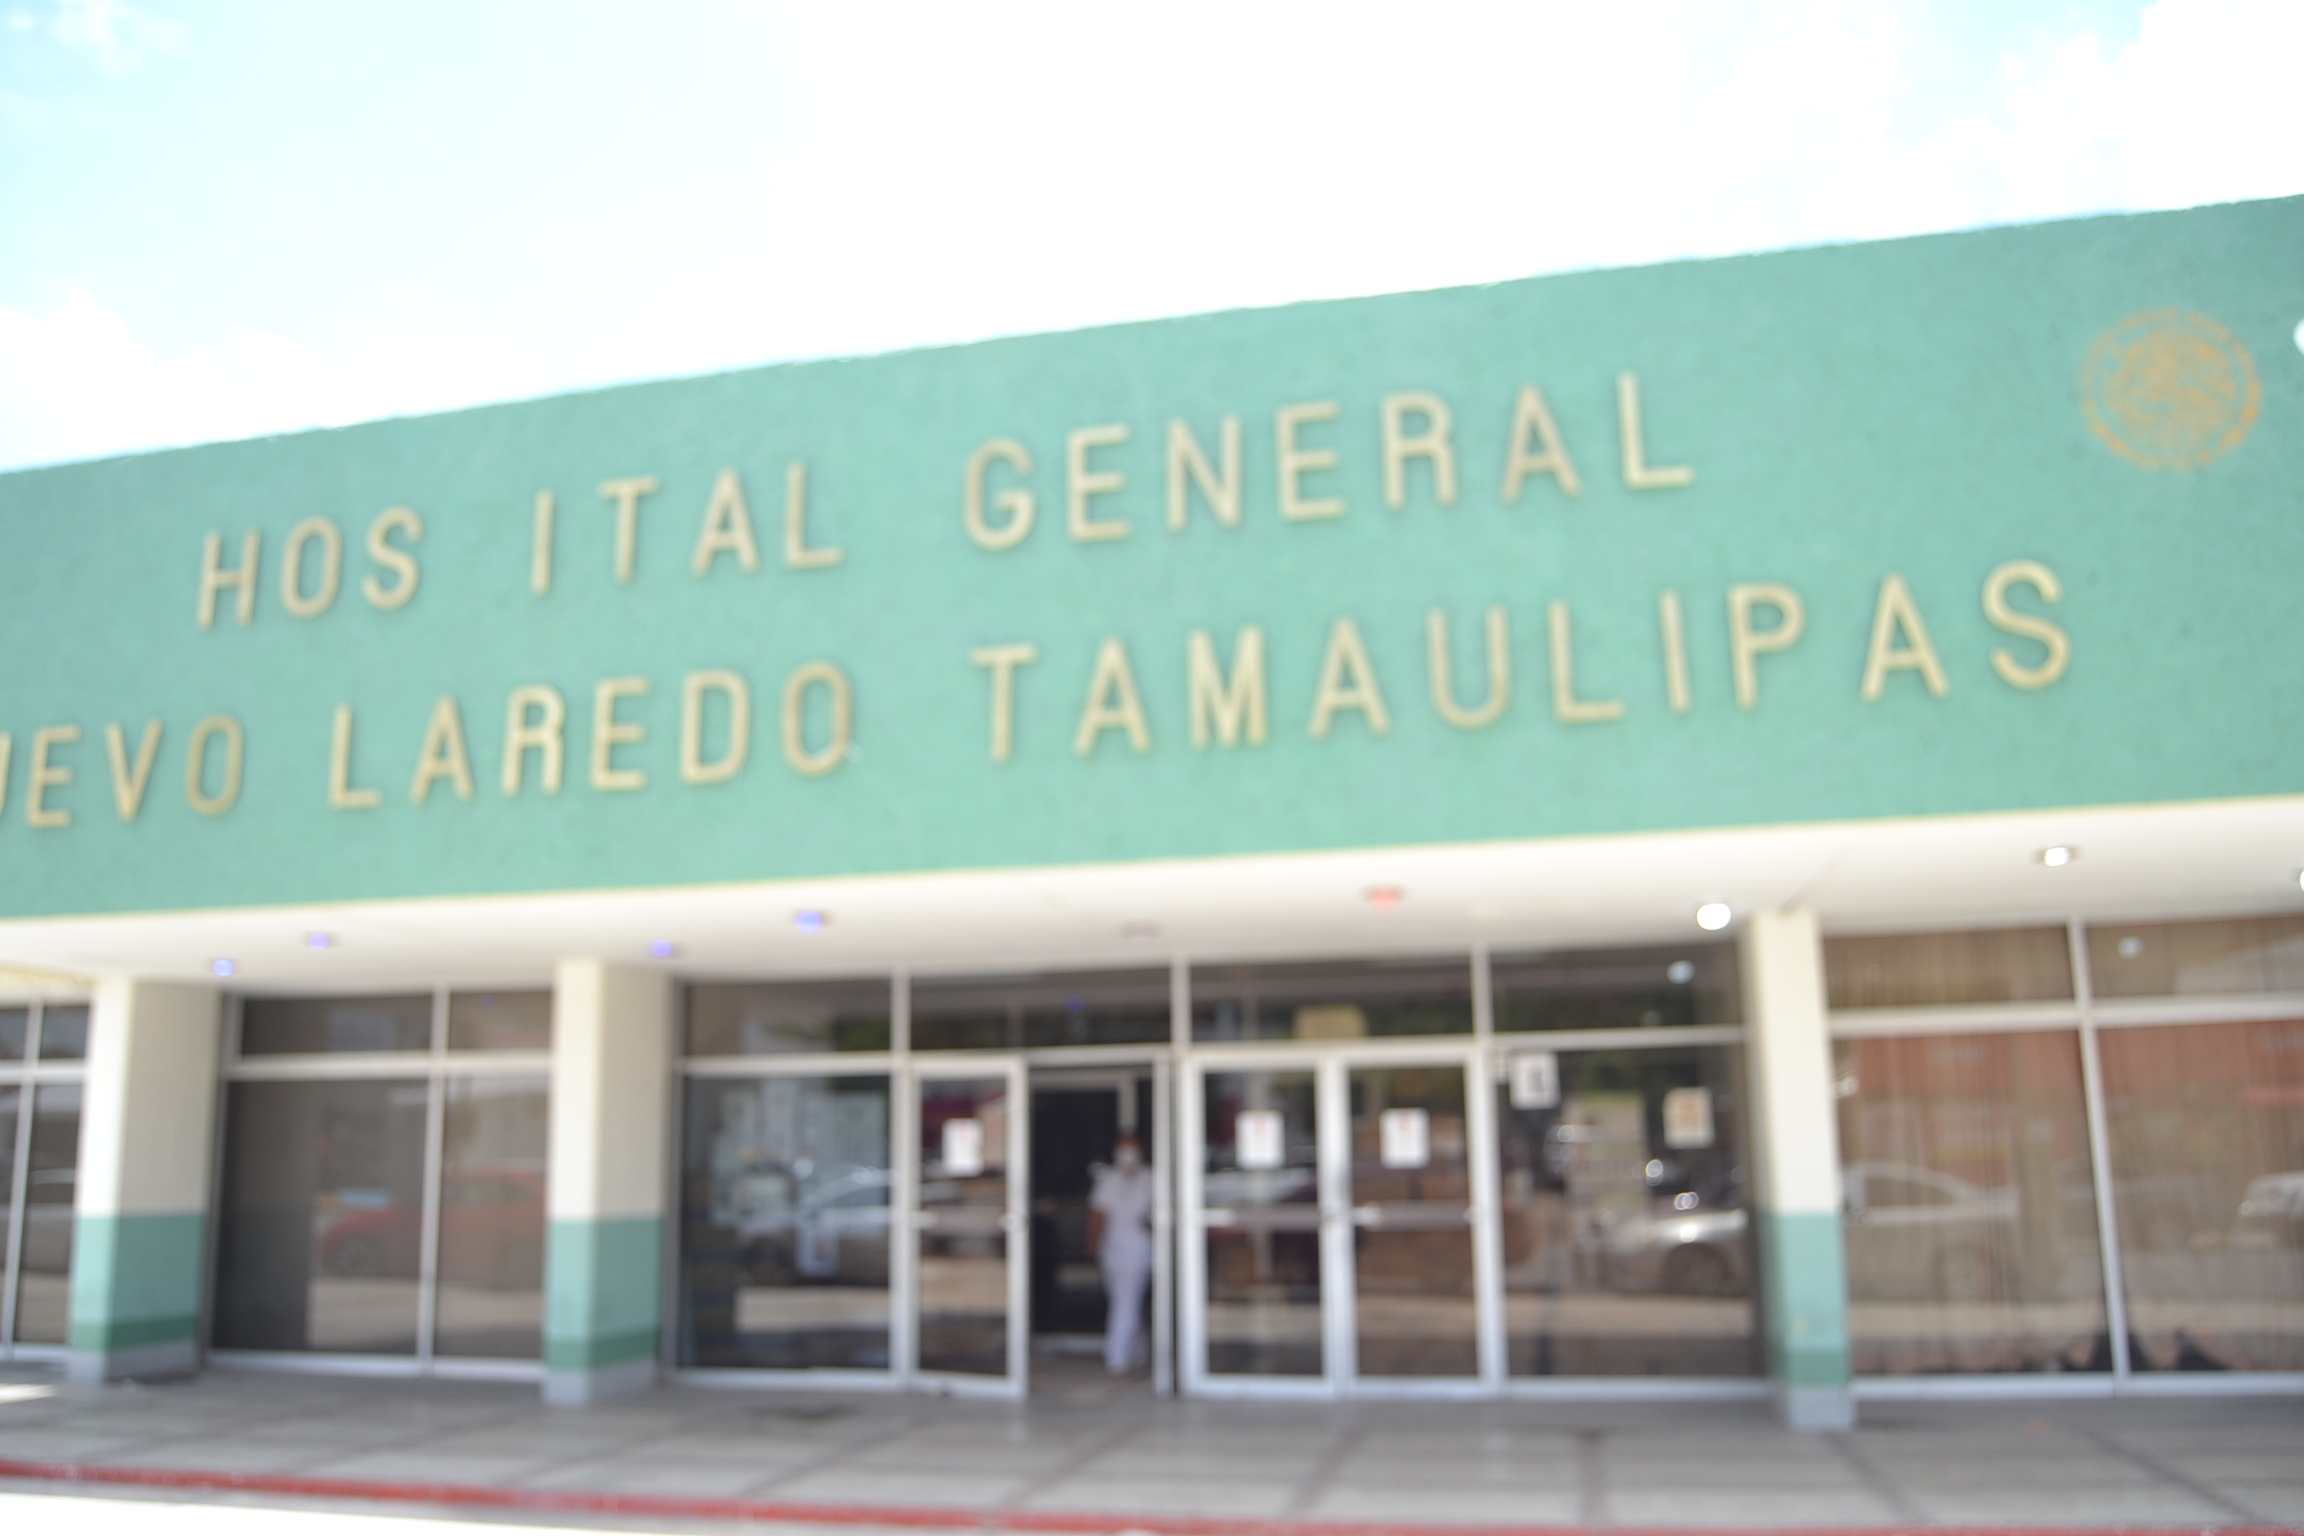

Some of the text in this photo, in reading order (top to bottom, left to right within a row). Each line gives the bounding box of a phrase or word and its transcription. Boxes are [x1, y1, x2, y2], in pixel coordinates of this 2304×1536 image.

[963, 371, 1695, 550] GENERAL
[330, 661, 853, 809] LAREDO
[970, 559, 2072, 762] TAMAULIPAS
